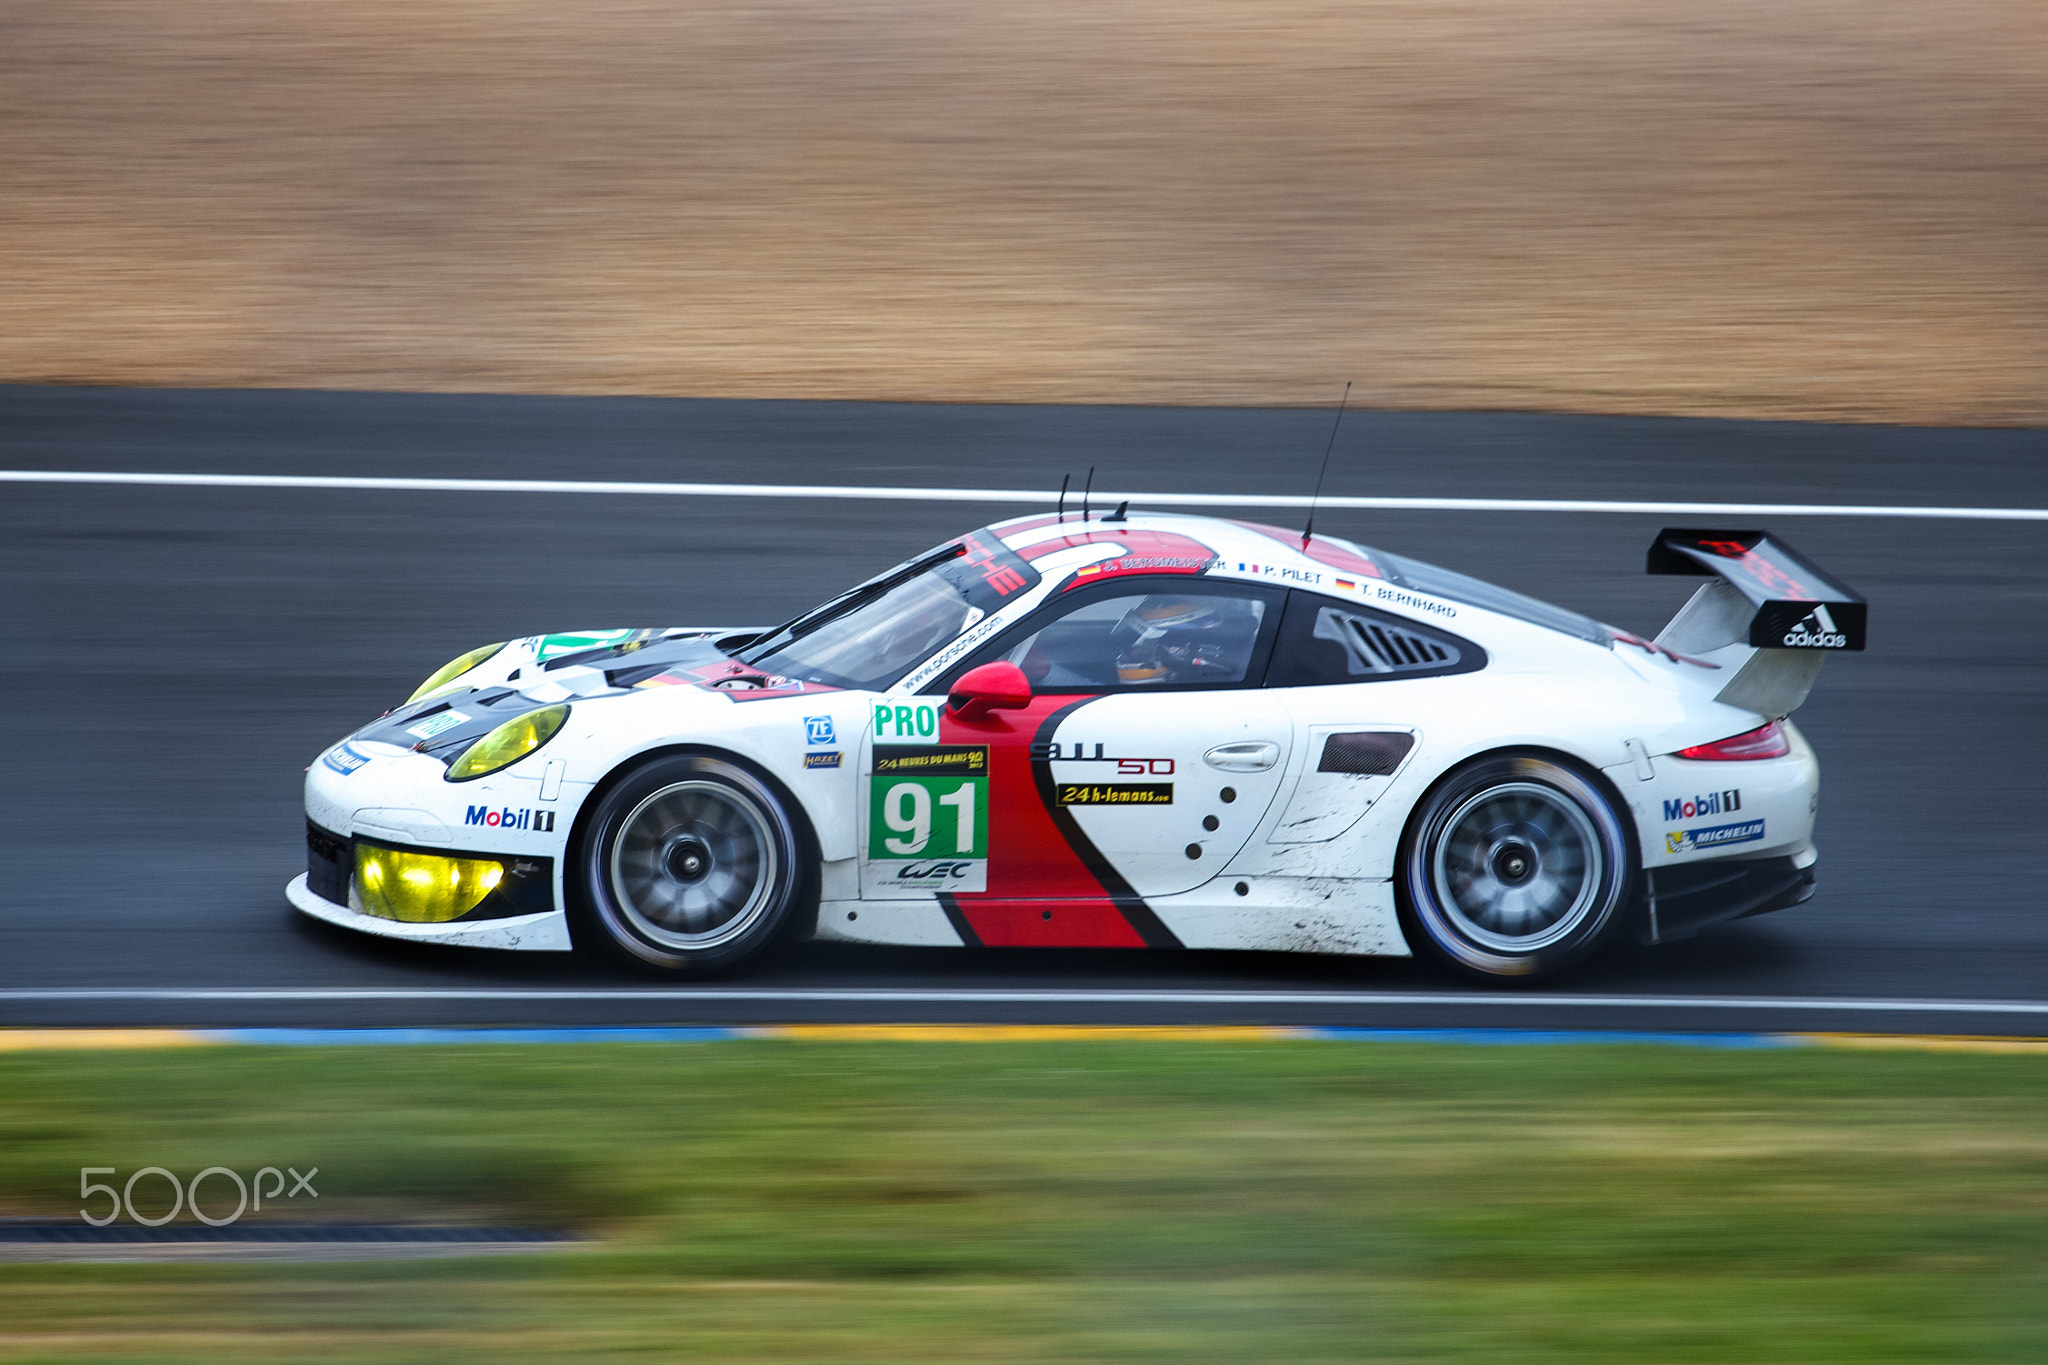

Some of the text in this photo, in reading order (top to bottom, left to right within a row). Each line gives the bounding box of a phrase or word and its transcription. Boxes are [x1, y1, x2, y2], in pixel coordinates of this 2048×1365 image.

[1264, 565, 1322, 584] P. PILET
[1361, 584, 1457, 618] T. BERNHARD
[1783, 630, 1847, 648] adidas
[902, 616, 1003, 690] www.porsche.com
[807, 720, 831, 739] ZF
[875, 704, 935, 737] PRO
[877, 758, 897, 770] 24
[899, 755, 929, 768] HEURES
[930, 755, 943, 764] DU
[1117, 758, 1175, 775] 50
[1663, 792, 1720, 822] Mobil
[464, 805, 531, 830] Mobil
[884, 782, 975, 854] 91
[1696, 823, 1764, 843] MICHELIN
[897, 861, 973, 879] WEC
